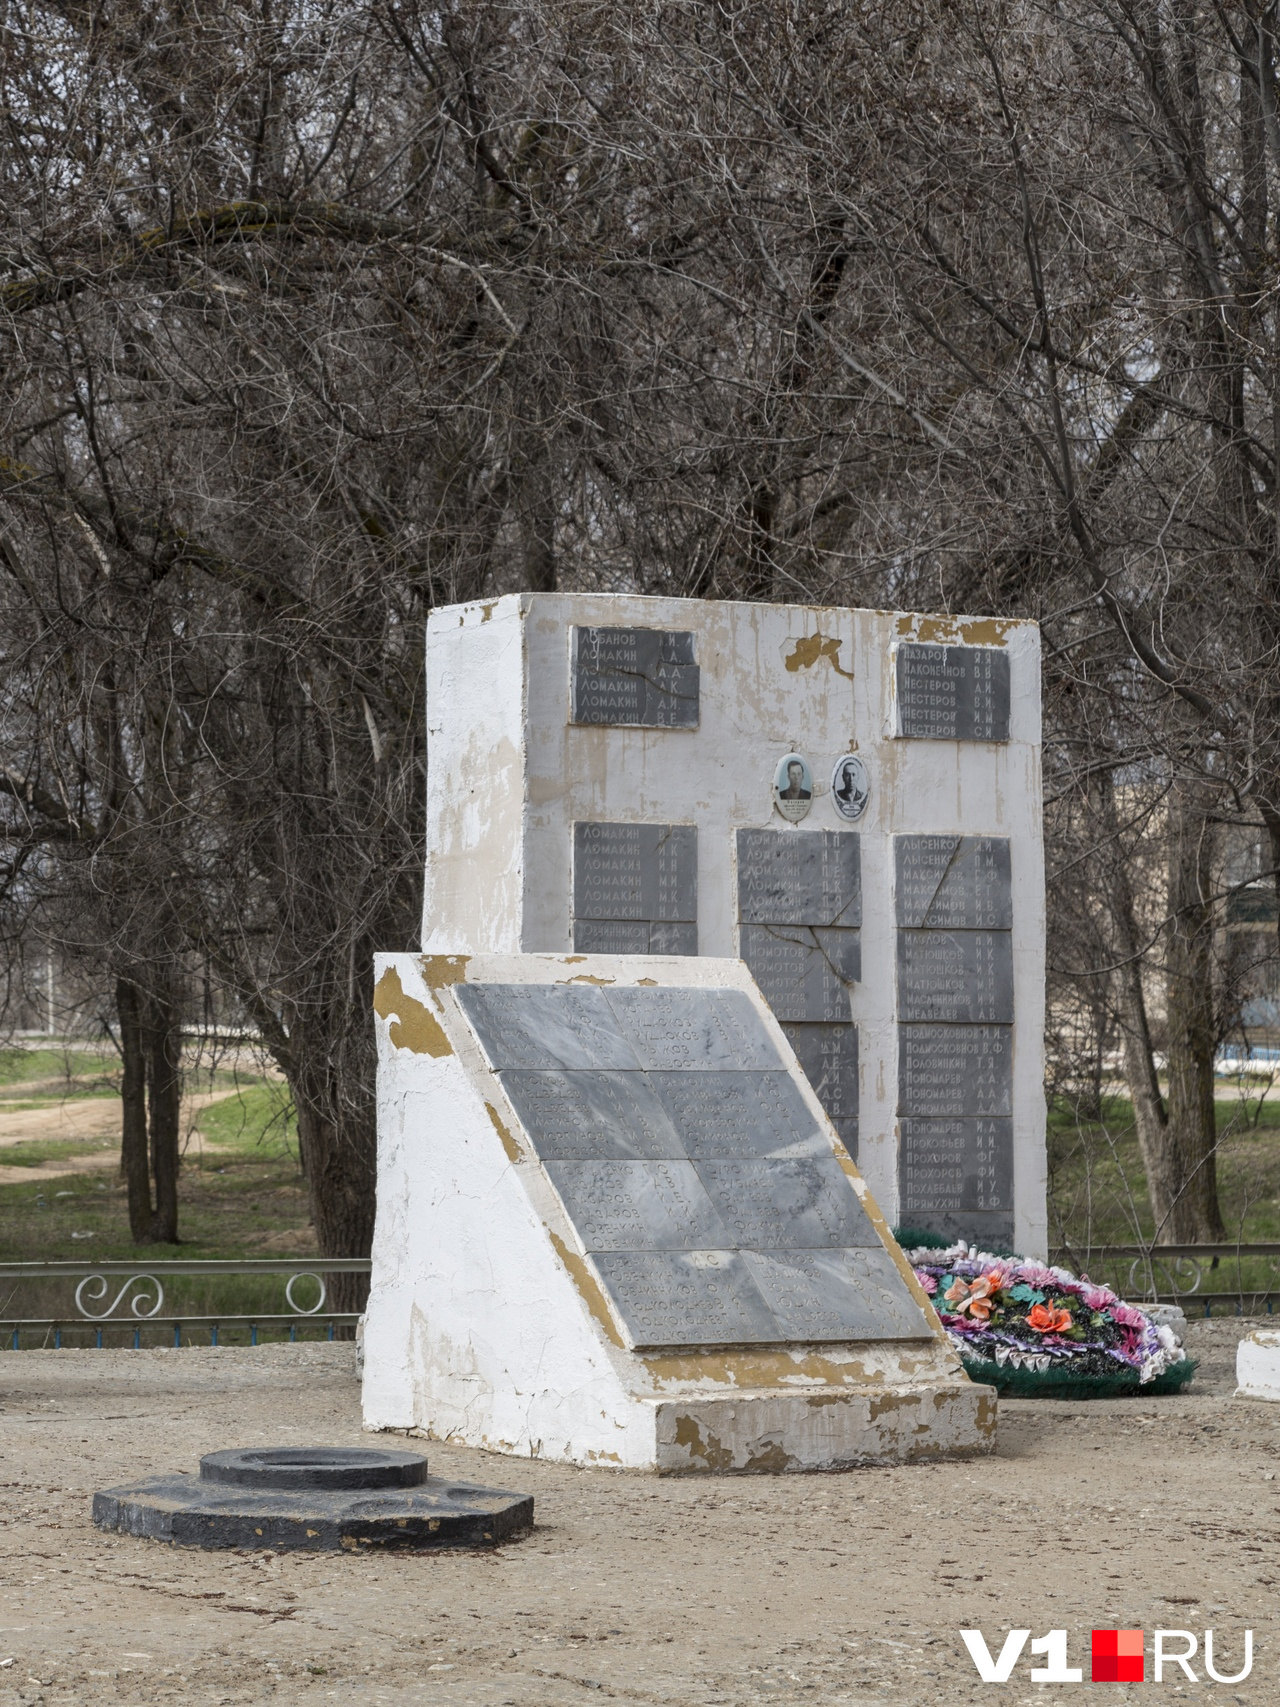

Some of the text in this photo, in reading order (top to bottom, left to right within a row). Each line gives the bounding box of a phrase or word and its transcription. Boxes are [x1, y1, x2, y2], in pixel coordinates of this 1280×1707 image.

[581, 634, 636, 645] ЛОБАНОВ
[581, 650, 636, 660] ЛОМАКИН
[904, 648, 947, 661] НАЗАРОВ
[581, 679, 636, 692] ЛОМАКИН
[904, 677, 956, 691] НЕСТЕРОВ
[581, 695, 638, 707] ЛОМАКИН
[904, 692, 956, 706] НЕСТЕРОВ
[581, 711, 639, 724] ЛОМАКИН
[904, 706, 956, 721] НЕСТЕРОВ
[904, 721, 956, 736] НЕСТЕРОВ
[584, 827, 639, 839] ЛОМАКИН
[584, 842, 640, 854] ЛОМАКИН
[584, 859, 641, 870] ЛОМАКИН
[584, 875, 641, 886] ЛОМАКИН
[584, 890, 642, 901] ЛОМАКИН
[904, 899, 965, 911] МАКСИМОВ
[584, 906, 642, 917] ЛОМАКИН
[905, 914, 966, 926] МАКСИМОВ
[906, 948, 963, 960] МАТЮШКОВ
[906, 963, 964, 975] МАТЮШКОВ
[907, 979, 964, 990] МАТЮШКОВ
[908, 1007, 957, 1019] МЕДВЕДЕВ
[907, 1027, 978, 1039] ПОДМОСКОВНОВ
[907, 1042, 978, 1054] ПОДМОСКОВНОВ
[906, 1072, 961, 1084] ПОНОМАРЕВ
[906, 1088, 961, 1099] ПОНОМАРЕВ
[907, 1122, 962, 1134] ПОНОМАРЕВ
[907, 1138, 965, 1149] ПРОКОФЬЕВ
[907, 1152, 961, 1164] ПРОХОРОВ
[907, 1197, 960, 1209] ПРЯМУХИН
